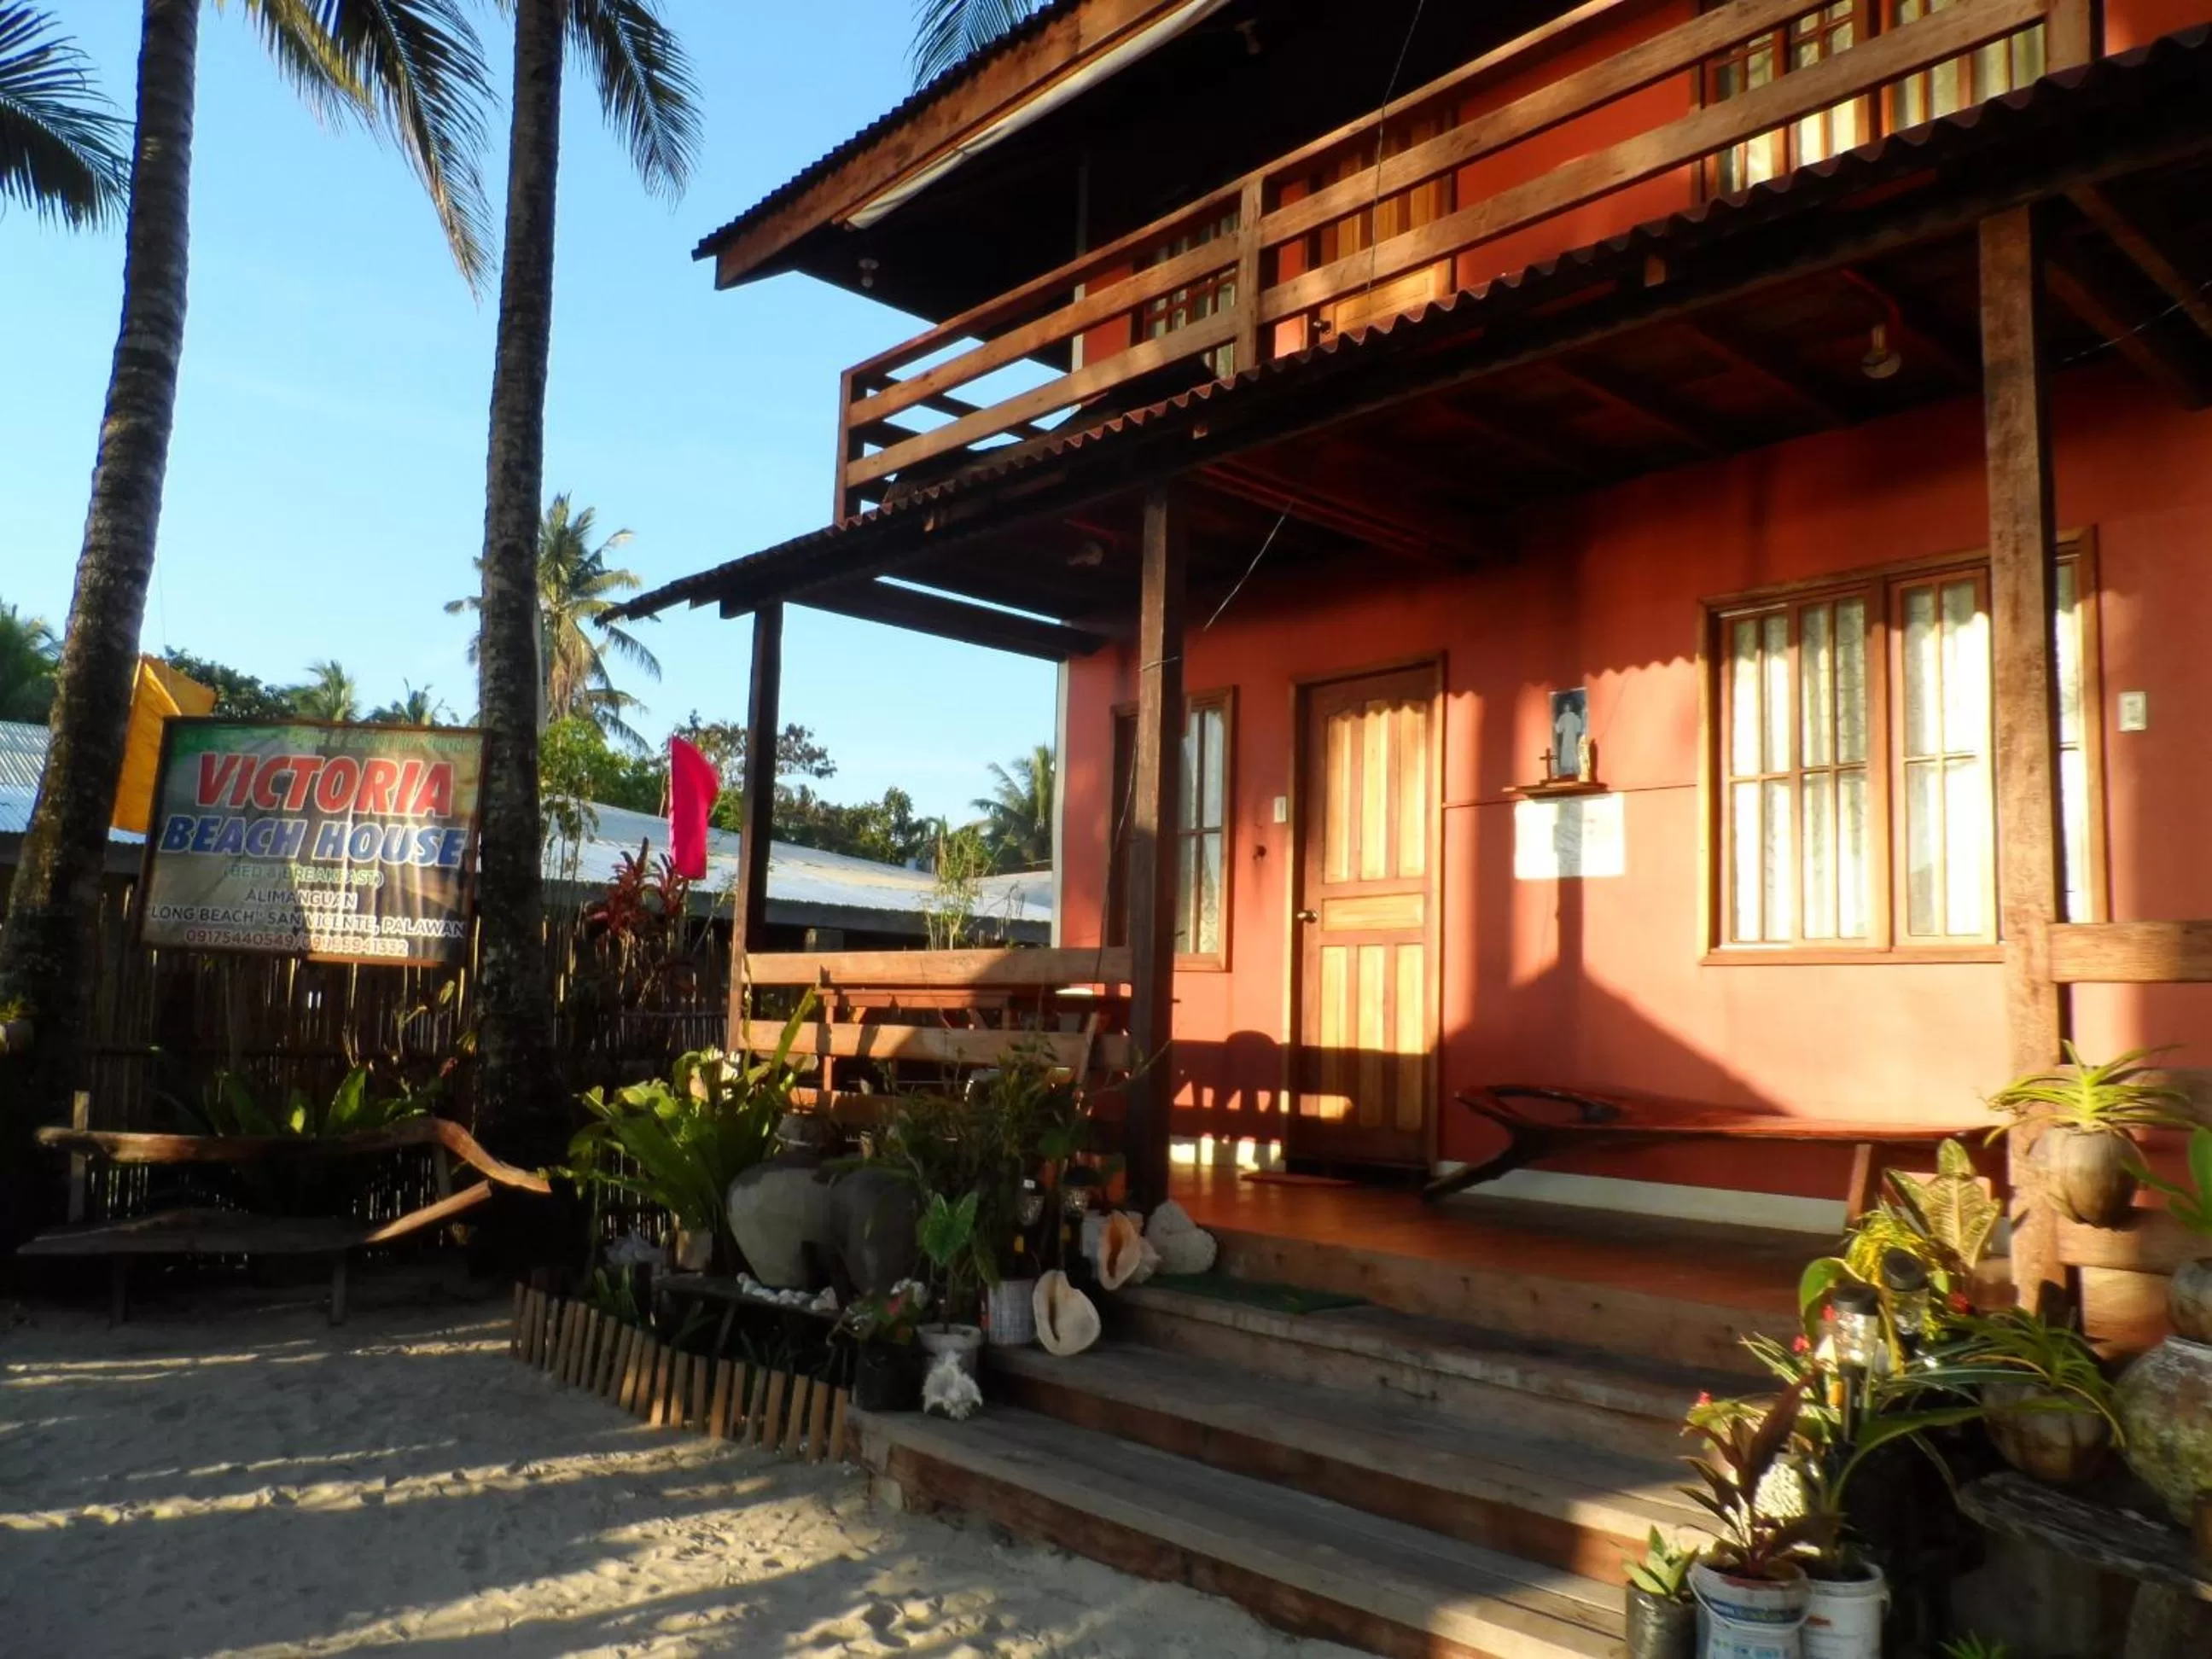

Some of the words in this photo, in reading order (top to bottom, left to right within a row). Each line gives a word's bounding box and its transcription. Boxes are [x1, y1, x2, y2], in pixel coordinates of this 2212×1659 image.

[195, 753, 454, 818] VICTORIA
[160, 814, 307, 859] BEACH
[312, 820, 469, 869] HOUSE
[244, 888, 358, 908] ALIMANGUAN
[267, 911, 303, 927] SAN
[305, 911, 380, 935] VICENTE,
[381, 916, 466, 939] PALAWAN
